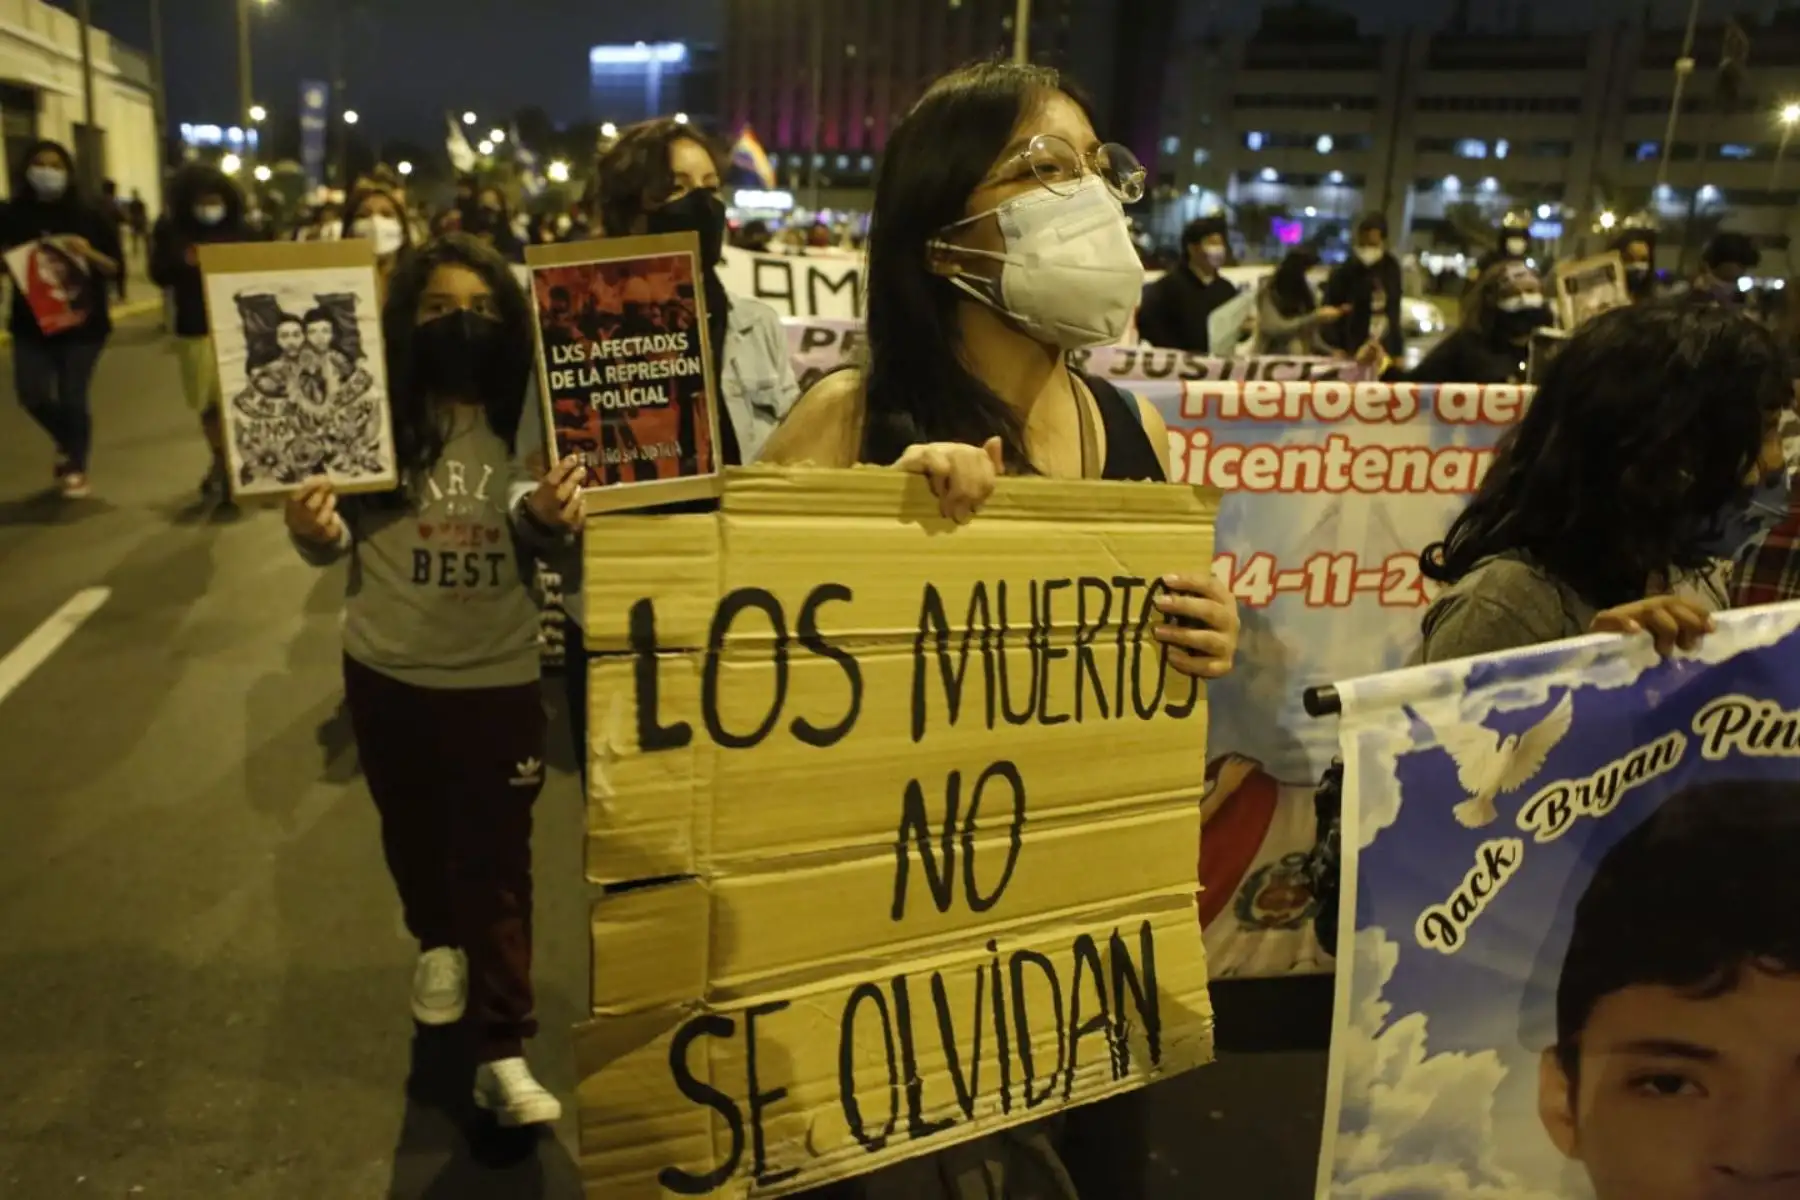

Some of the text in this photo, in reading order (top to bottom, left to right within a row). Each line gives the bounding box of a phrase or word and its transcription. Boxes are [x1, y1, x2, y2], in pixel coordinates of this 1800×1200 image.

[551, 354, 701, 391] DE LA REPRESIÓN
[552, 332, 689, 364] LXS AFECTADXS
[590, 385, 669, 411] POLICIAL
[411, 548, 506, 588] BEST
[628, 583, 864, 752] LOS
[891, 760, 1026, 921] NO
[1420, 698, 1800, 951] Jack Bryan Pin
[658, 1000, 804, 1195] SE
